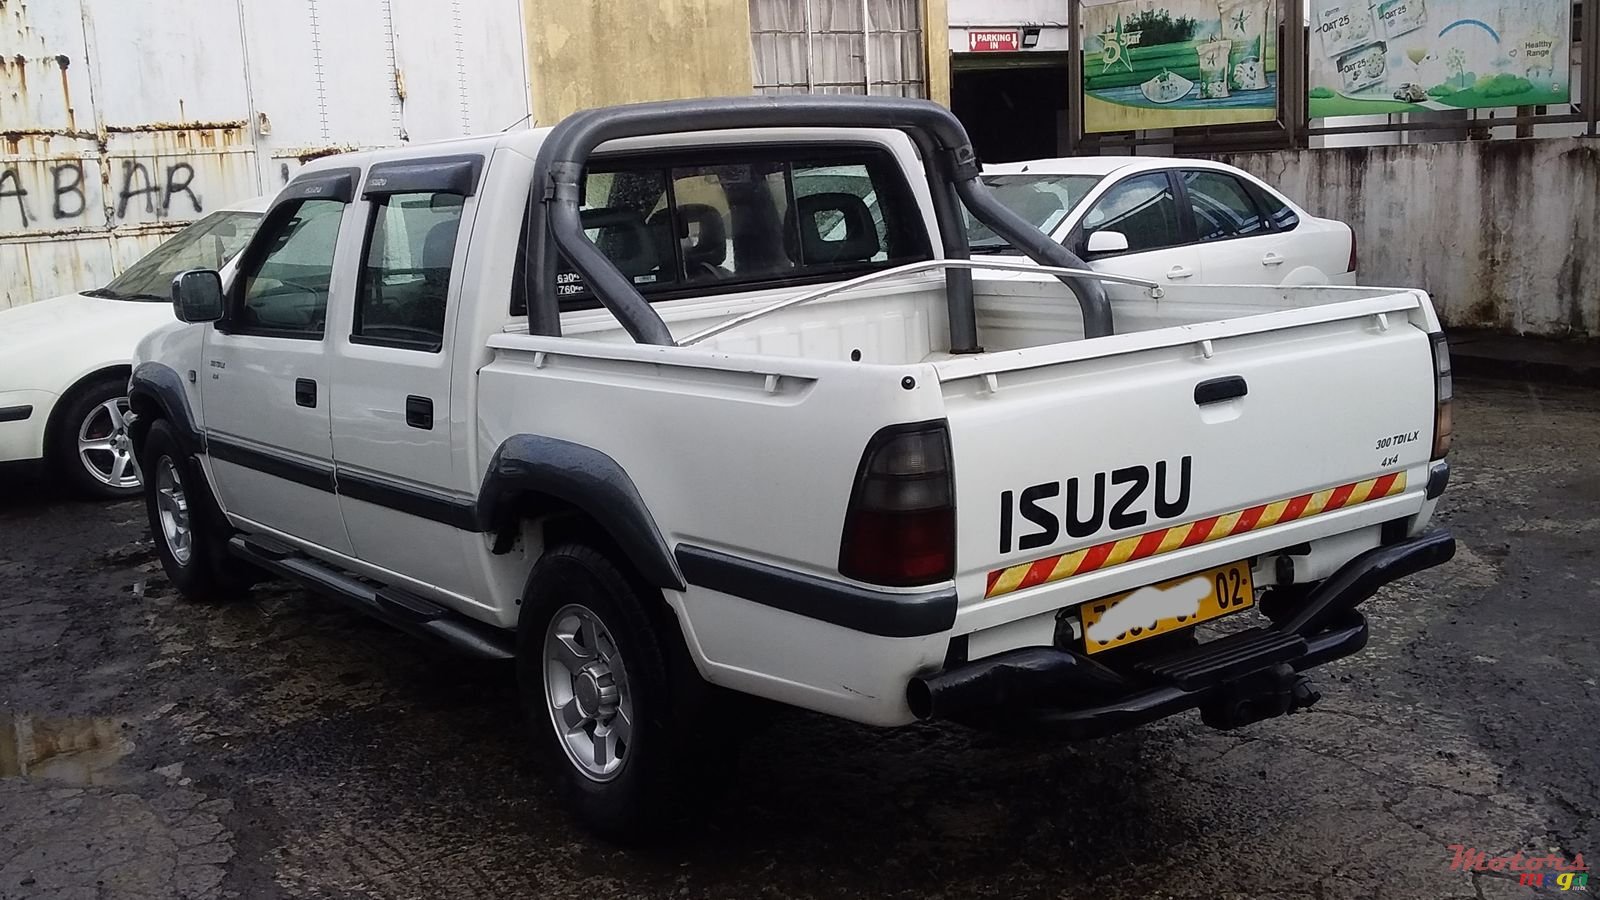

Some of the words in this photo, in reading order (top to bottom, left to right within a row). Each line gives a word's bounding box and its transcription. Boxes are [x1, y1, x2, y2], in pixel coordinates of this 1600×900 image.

[1384, 9, 1398, 19] OAT
[1398, 5, 1407, 15] 25
[1322, 19, 1338, 32] OAT
[1339, 14, 1350, 27] 25
[977, 33, 1011, 42] PARKING
[990, 41, 999, 49] IN
[1102, 32, 1121, 64] 5
[1119, 32, 1142, 46] Star
[1525, 41, 1552, 49] Healthy
[1343, 62, 1357, 73] OAT
[1357, 58, 1367, 69] 25
[1376, 437, 1391, 450] 300
[1381, 454, 1399, 467] 4x4
[1000, 455, 1192, 554] ISUZU
[1215, 568, 1244, 610] 02
